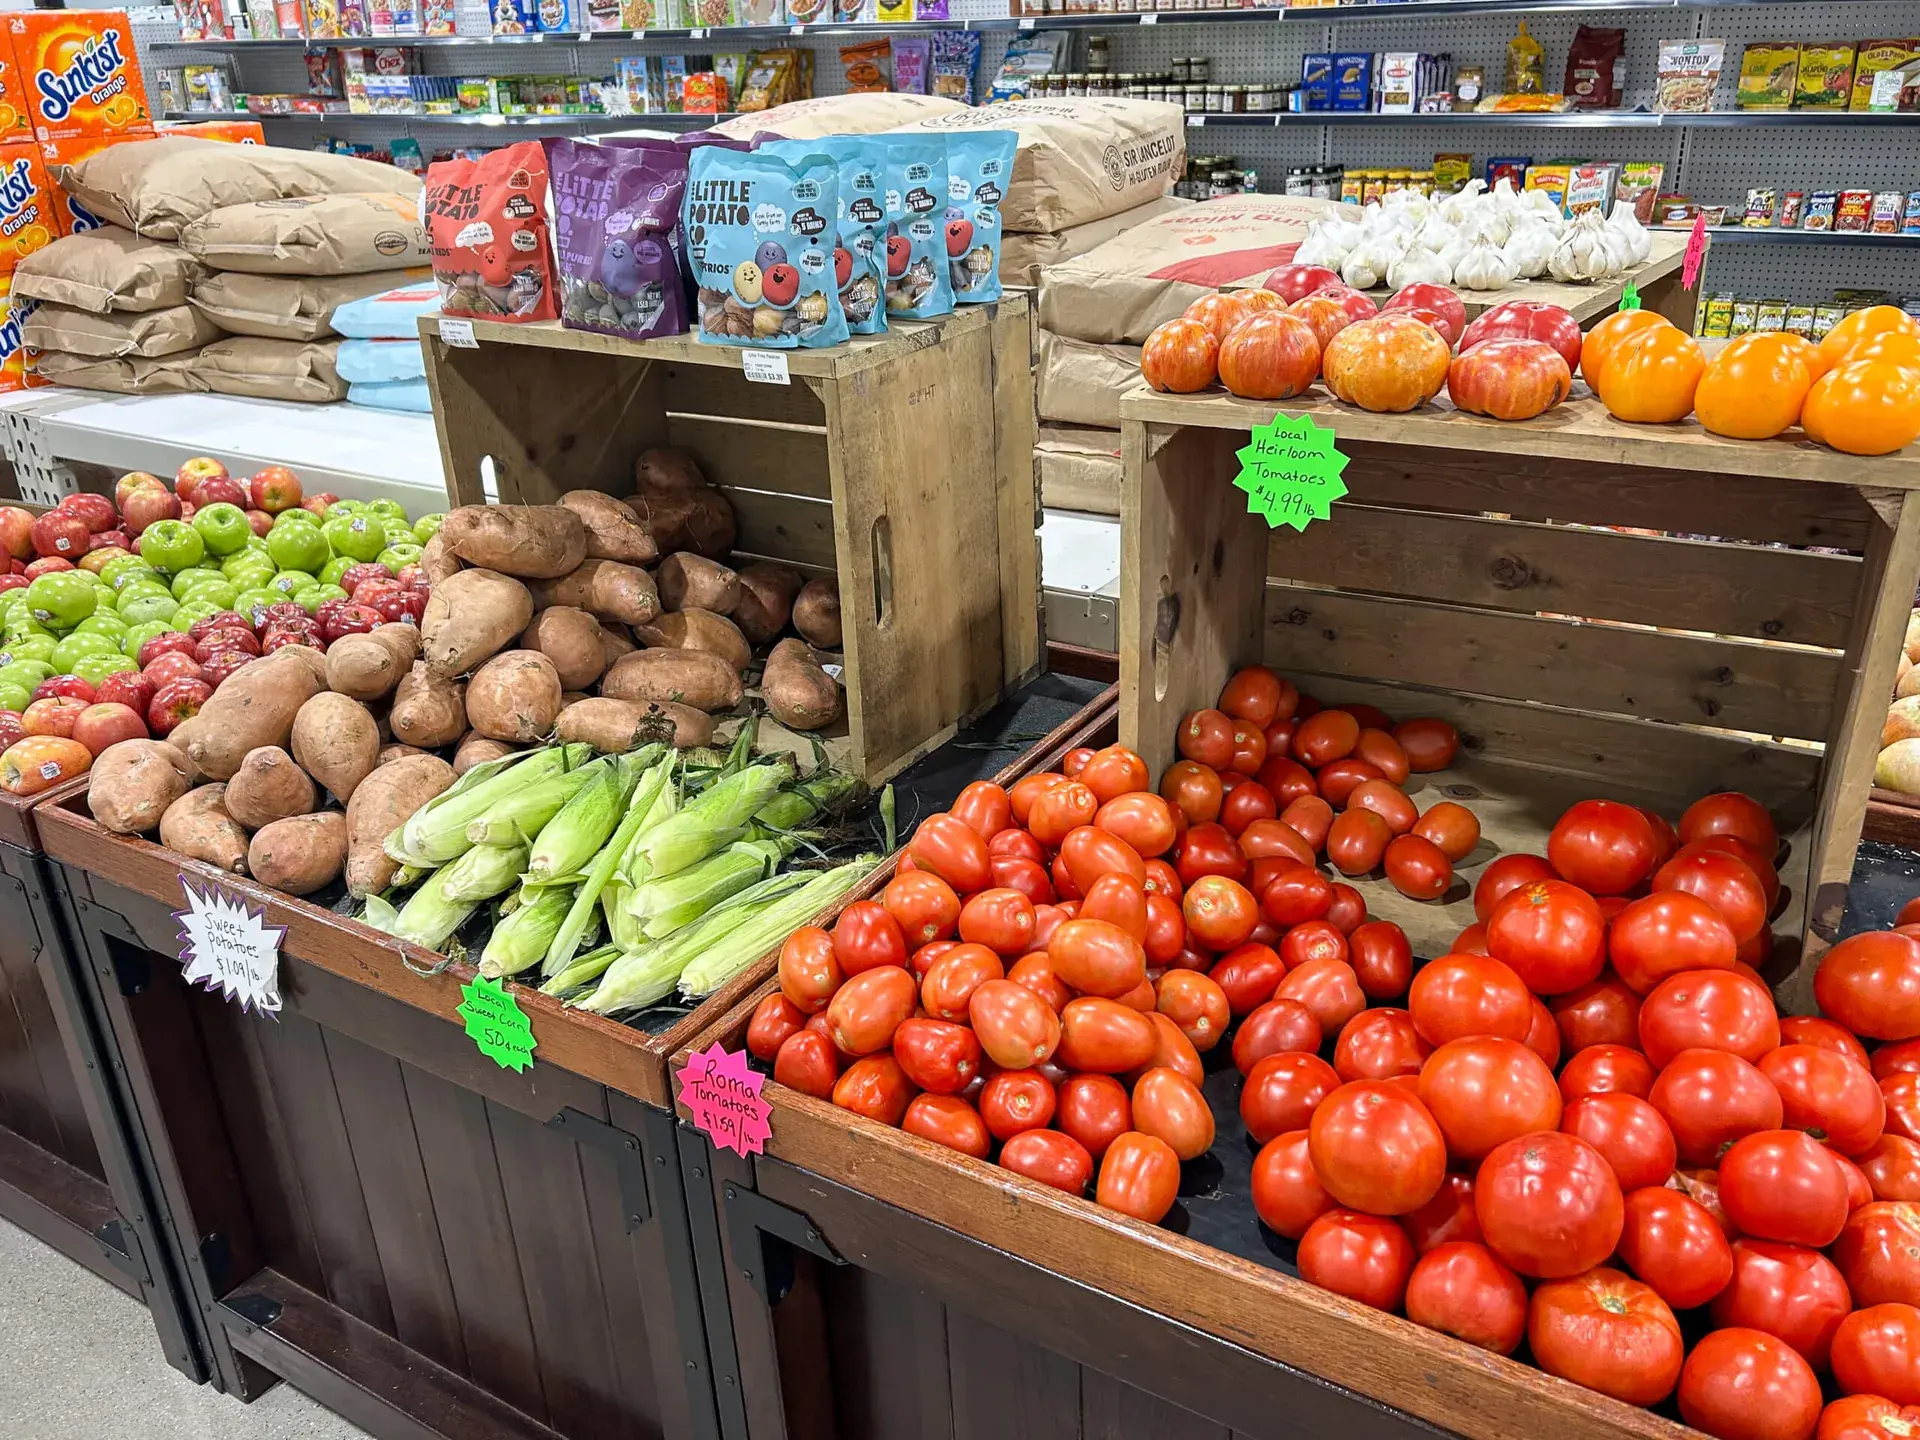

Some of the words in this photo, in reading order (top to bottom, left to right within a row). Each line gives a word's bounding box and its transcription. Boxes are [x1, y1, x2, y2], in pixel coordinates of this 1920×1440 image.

[1670, 55, 1710, 66] WONTON
[35, 28, 125, 121] Sunkist
[90, 75, 126, 104] Orange
[1123, 147, 1138, 168] SIR
[1137, 134, 1176, 164] LANCELOT
[1128, 164, 1157, 186] HI-GLUTEN
[3, 205, 38, 236] Orange
[425, 199, 479, 221] OTATO
[689, 203, 750, 226] POTATO
[689, 225, 709, 246] CO.
[1275, 427, 1307, 442] Local
[1255, 438, 1326, 460] Heirloom
[1250, 461, 1326, 486] Tomatoes
[204, 912, 245, 939] Sweet
[207, 931, 259, 959] Potatoes
[477, 987, 507, 1012] Local
[464, 1000, 496, 1021] Sweet
[499, 1013, 526, 1034] Corn
[704, 1059, 757, 1102] Roma
[690, 1081, 759, 1121] Tomatoes
